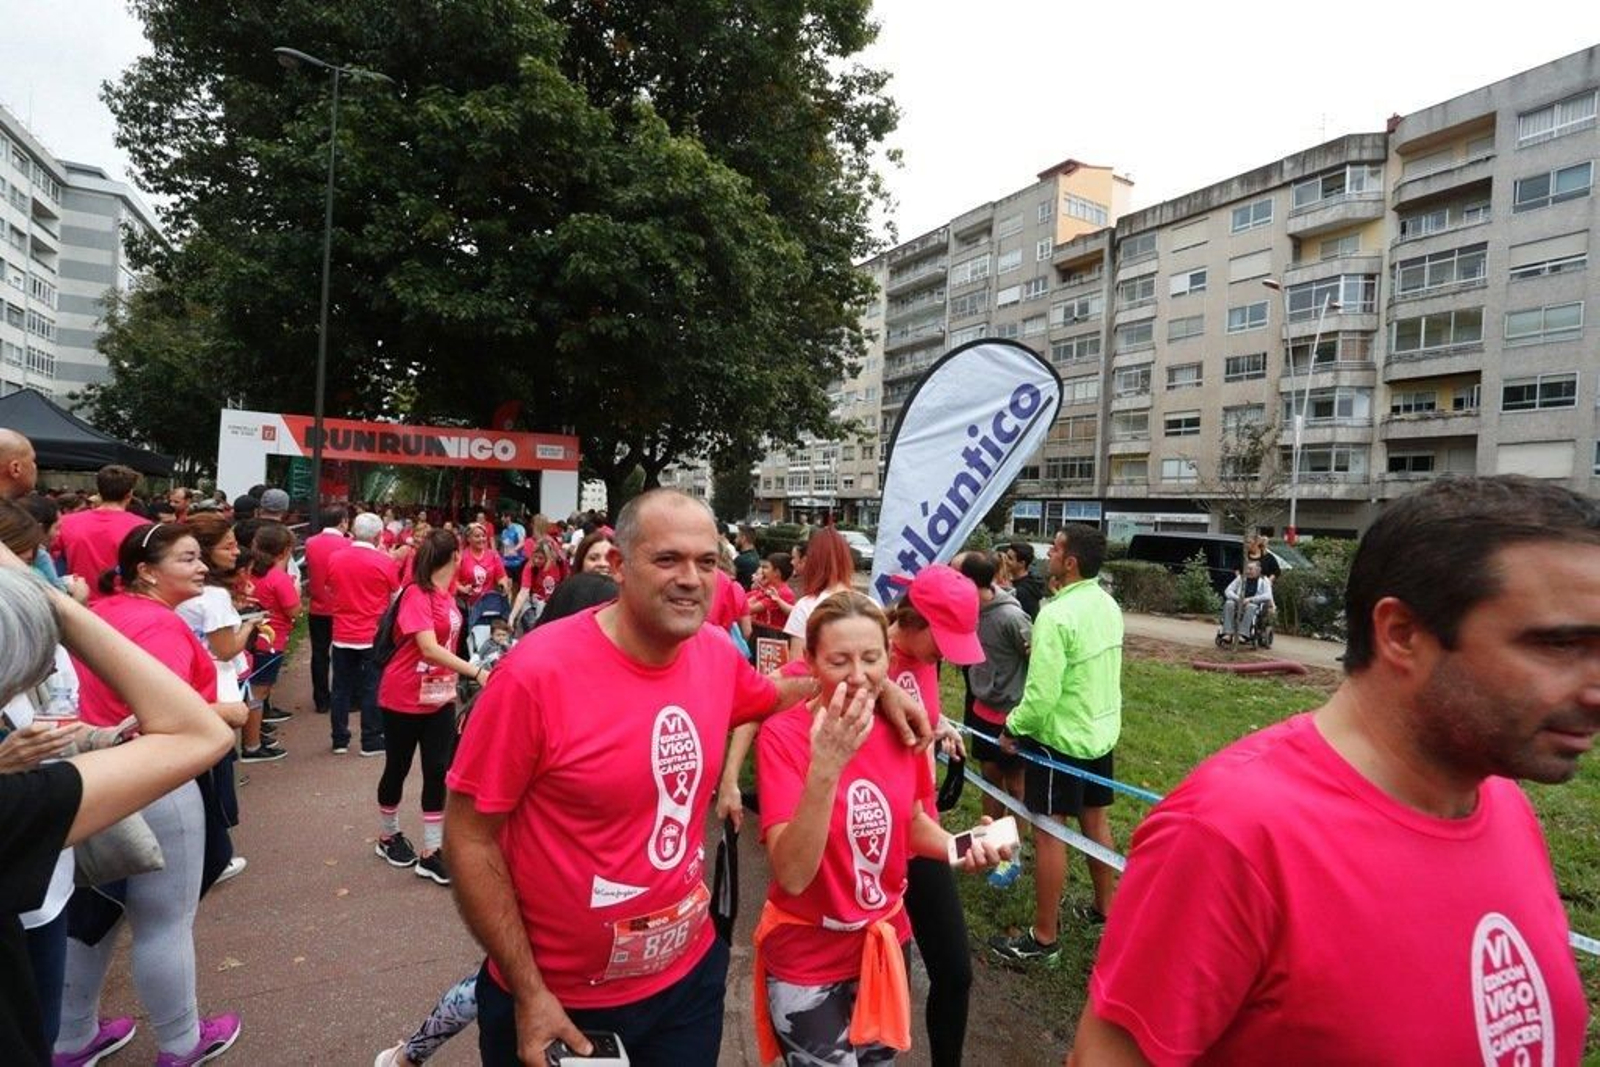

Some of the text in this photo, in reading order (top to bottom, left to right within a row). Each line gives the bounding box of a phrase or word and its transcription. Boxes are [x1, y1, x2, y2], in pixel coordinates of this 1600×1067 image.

[874, 383, 1041, 604] Atlántico
[663, 716, 683, 733] VI
[660, 740, 694, 756] VIGO
[855, 789, 870, 803] VI
[854, 808, 884, 823] VIGO
[643, 920, 690, 960] 826
[1485, 934, 1513, 969] VI
[1485, 981, 1535, 1019] VIGO
